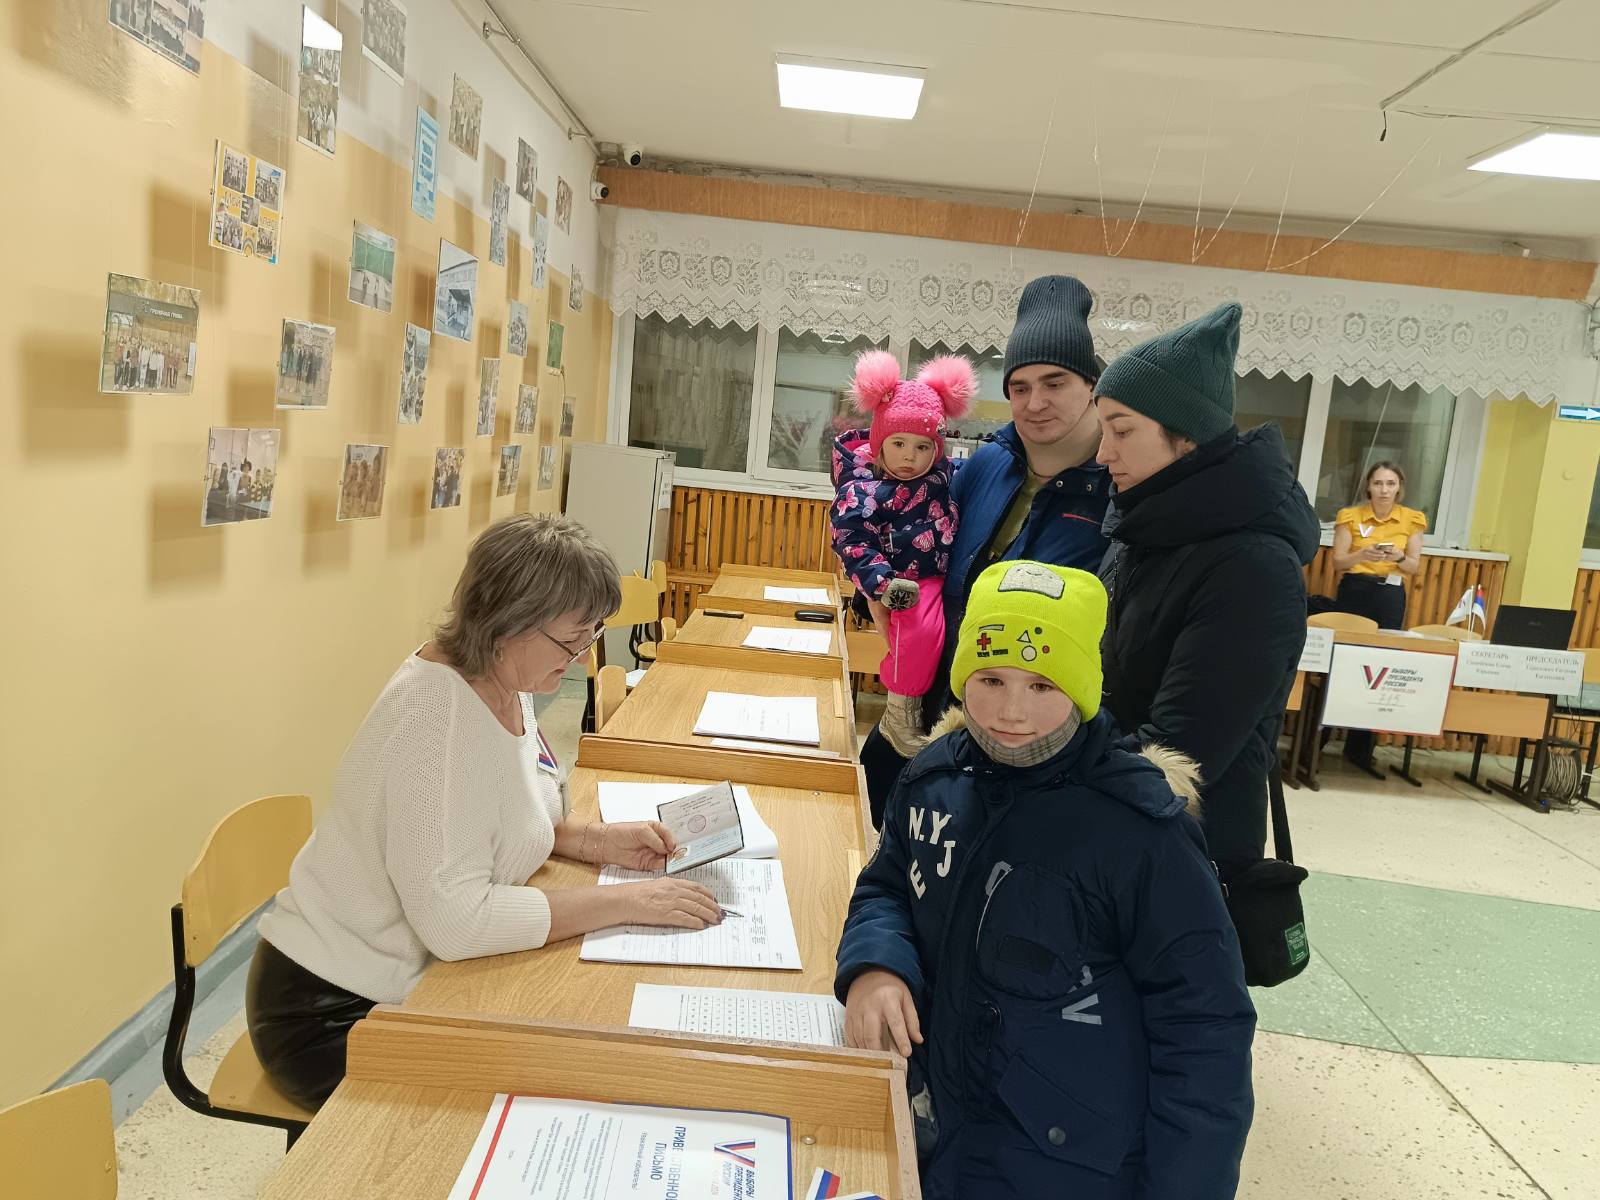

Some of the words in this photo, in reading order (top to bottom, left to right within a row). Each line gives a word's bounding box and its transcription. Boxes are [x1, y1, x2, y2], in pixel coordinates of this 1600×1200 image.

[1387, 674, 1424, 682] ПРЕЗИДЕНТА
[650, 1143, 667, 1181] ПИСЬМО
[745, 1169, 756, 1198] ВЫБОРЫ
